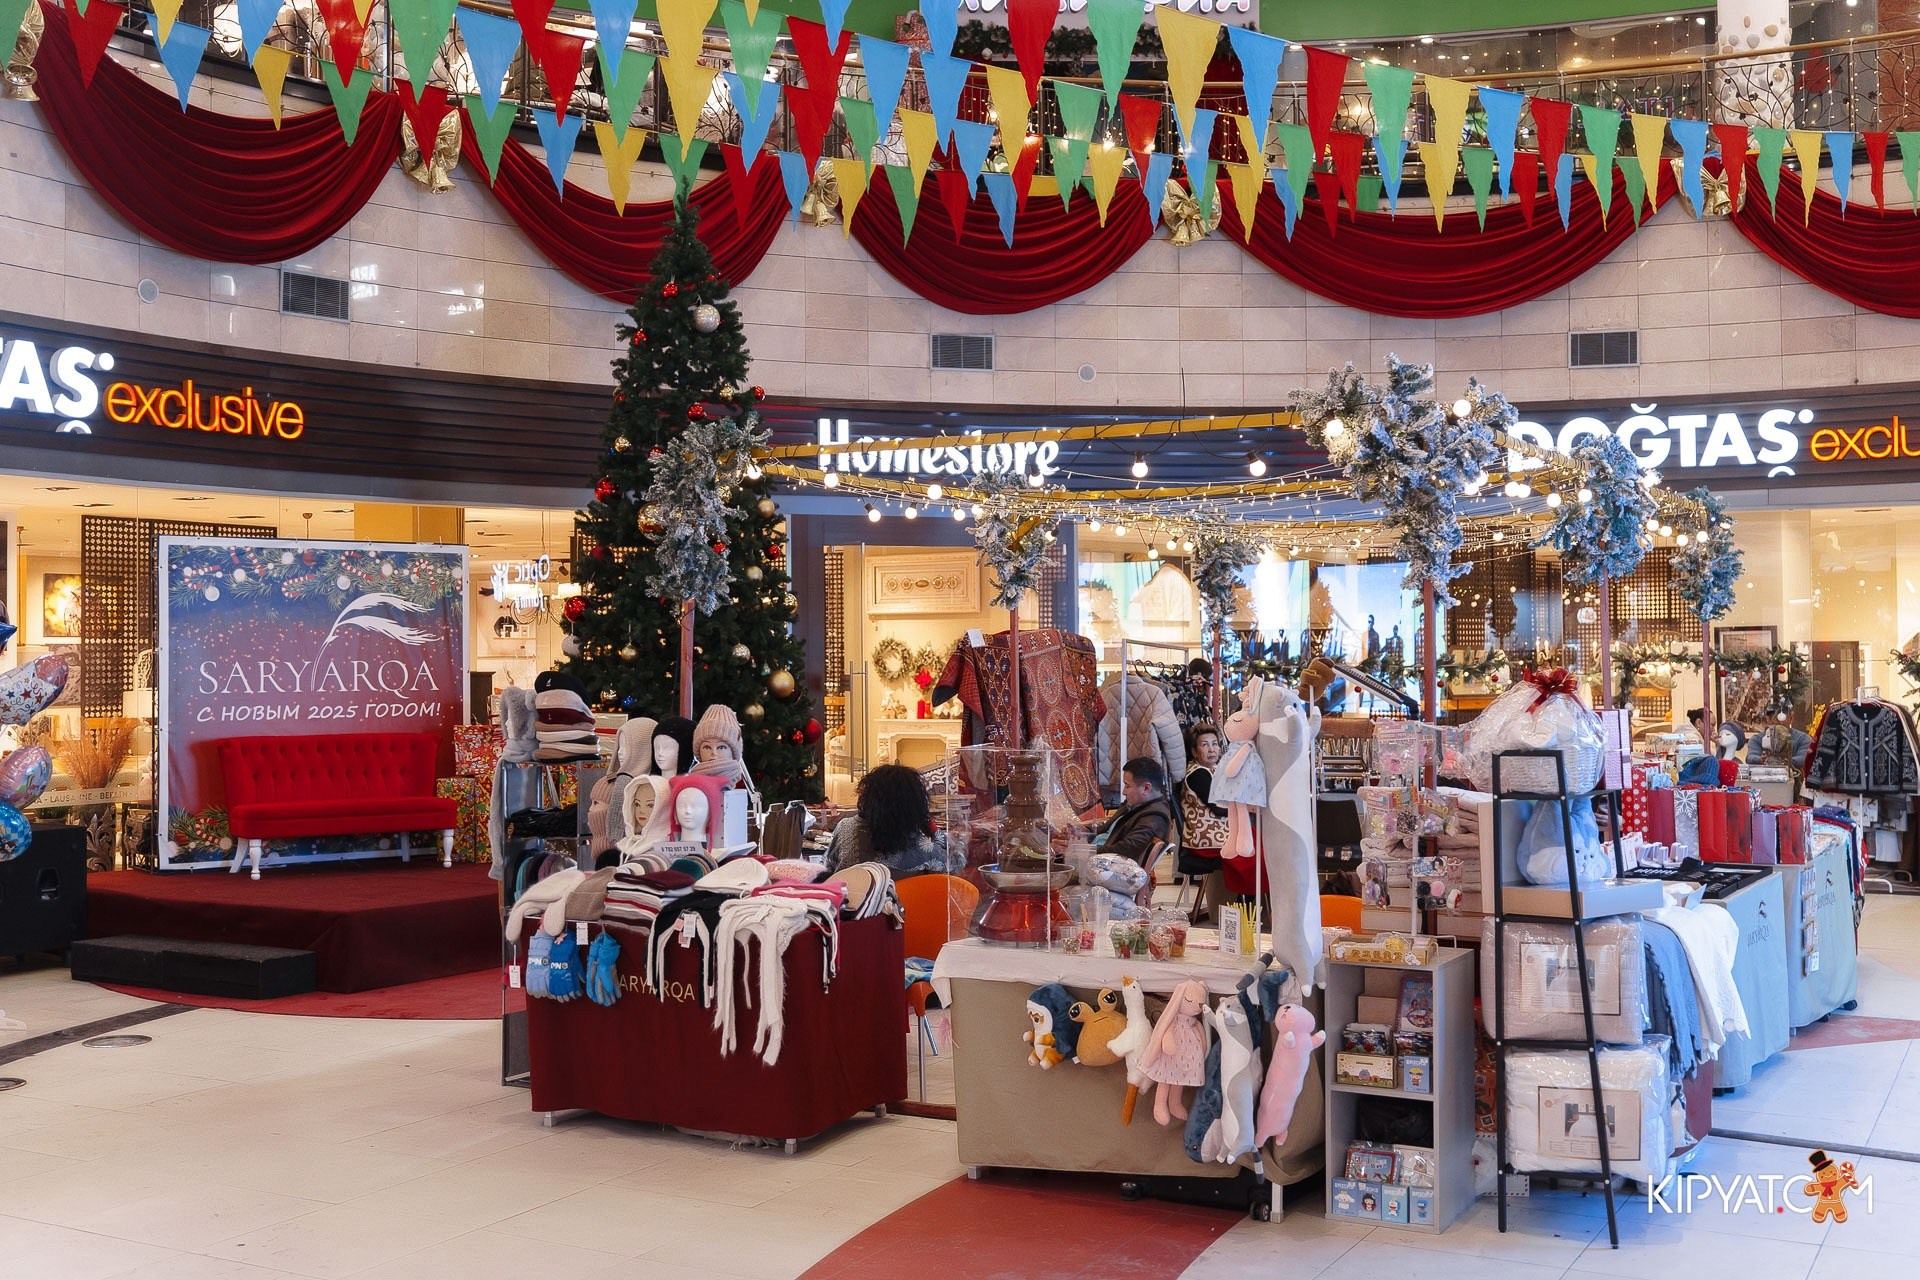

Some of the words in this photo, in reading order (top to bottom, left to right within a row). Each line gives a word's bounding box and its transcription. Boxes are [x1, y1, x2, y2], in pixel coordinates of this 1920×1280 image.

[104, 379, 304, 440] exclusive
[817, 418, 1060, 476] Homestore
[197, 706, 213, 722] С
[221, 704, 300, 722] НОВЫМ
[308, 704, 359, 720] 2025
[365, 702, 441, 719] ГОДОМ!
[619, 974, 695, 1003] ARYRQA
